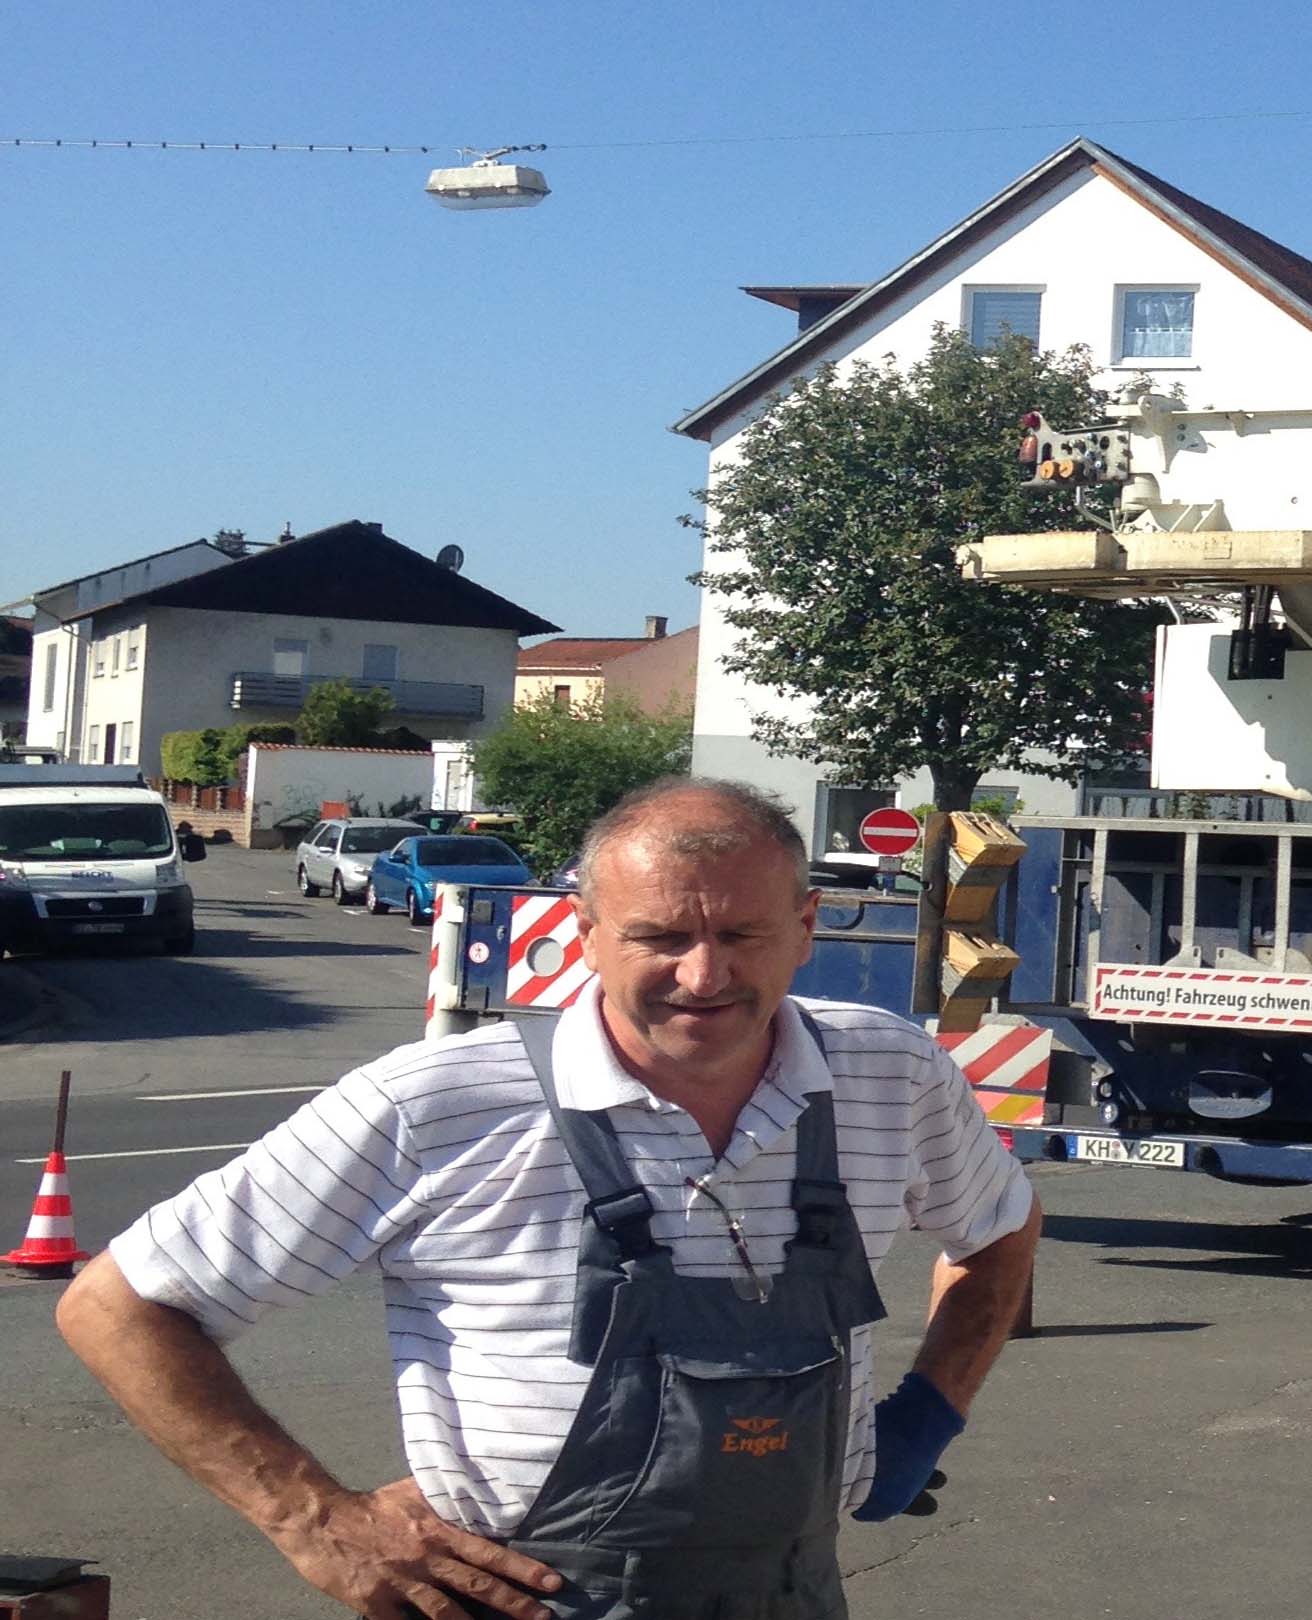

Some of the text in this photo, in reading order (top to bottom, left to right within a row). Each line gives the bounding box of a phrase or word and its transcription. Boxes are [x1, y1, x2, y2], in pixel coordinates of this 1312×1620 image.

[1103, 983, 1171, 1006] Achtung!
[1174, 987, 1247, 1011] Fahrzeug
[1084, 1139, 1176, 1163] KH Y 222
[719, 1431, 789, 1457] Engel
